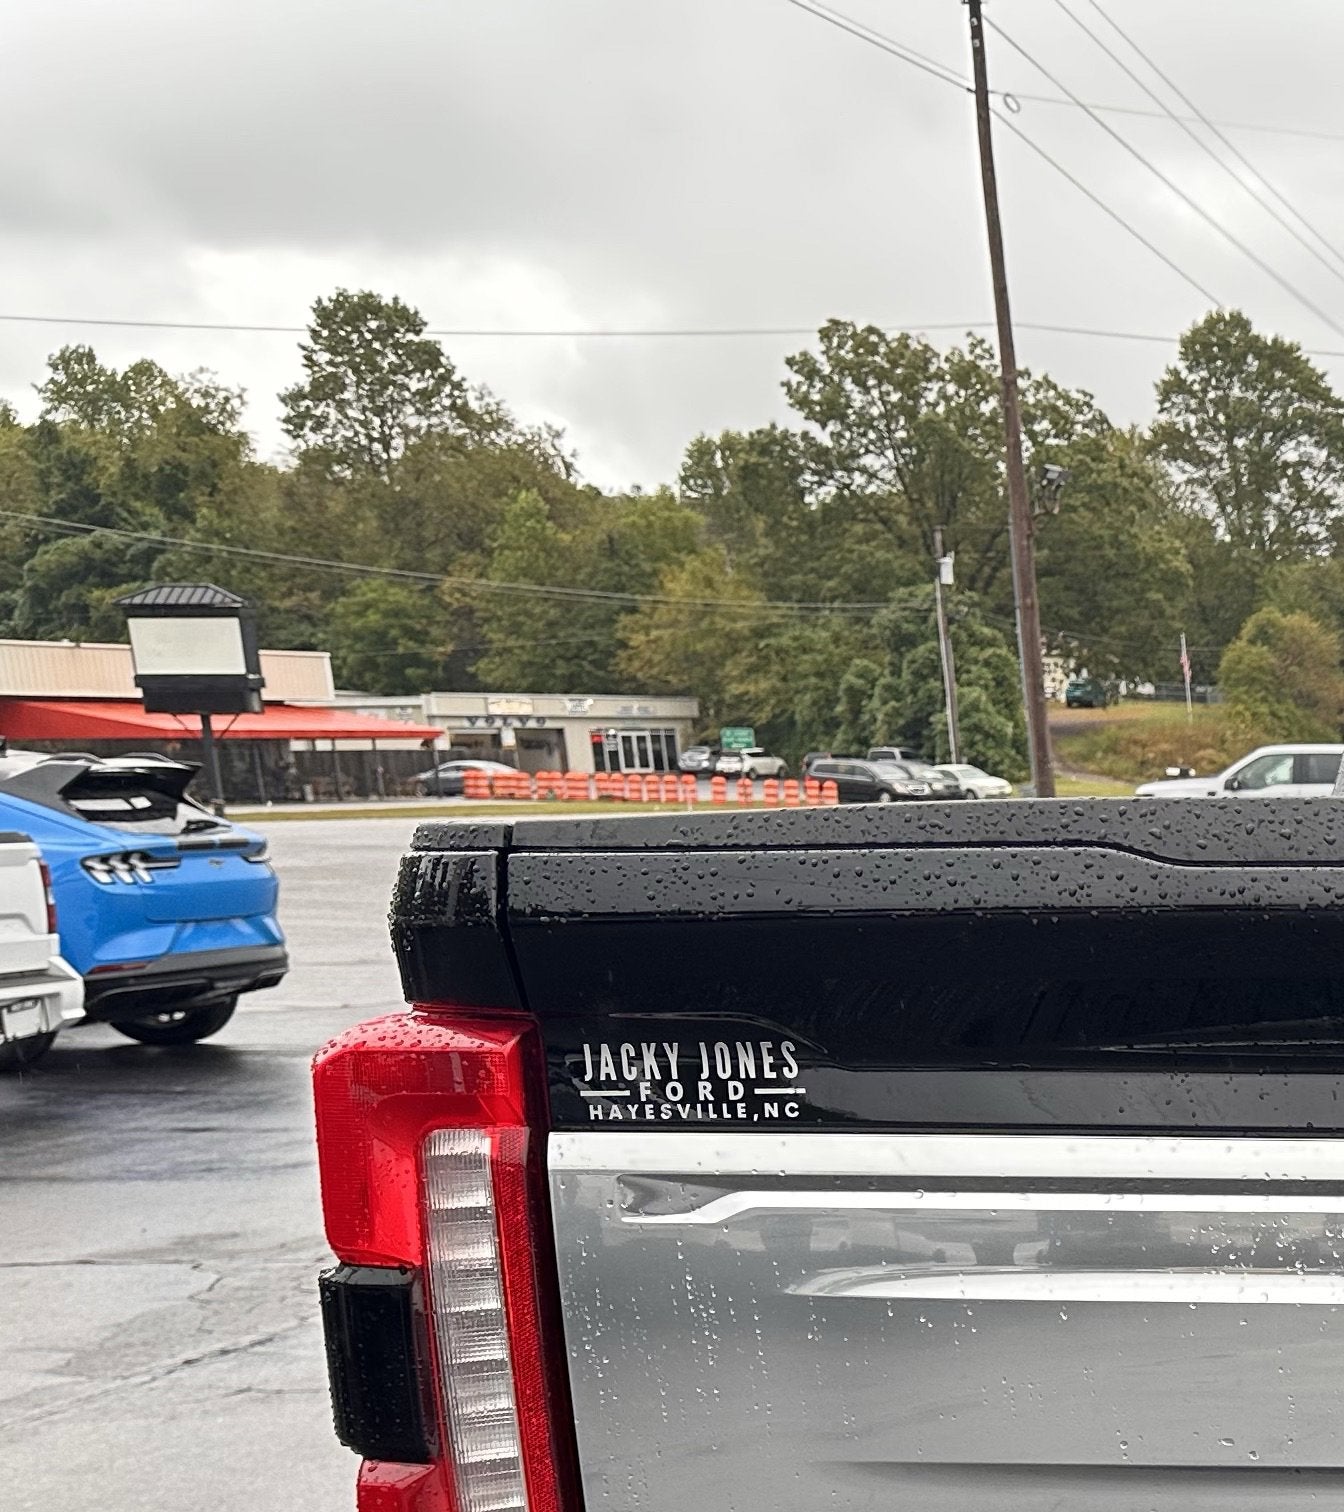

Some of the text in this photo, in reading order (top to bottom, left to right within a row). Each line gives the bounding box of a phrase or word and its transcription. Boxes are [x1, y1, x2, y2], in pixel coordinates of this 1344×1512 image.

[583, 1041, 799, 1081] JACKY JONES
[639, 1080, 745, 1102] FORD
